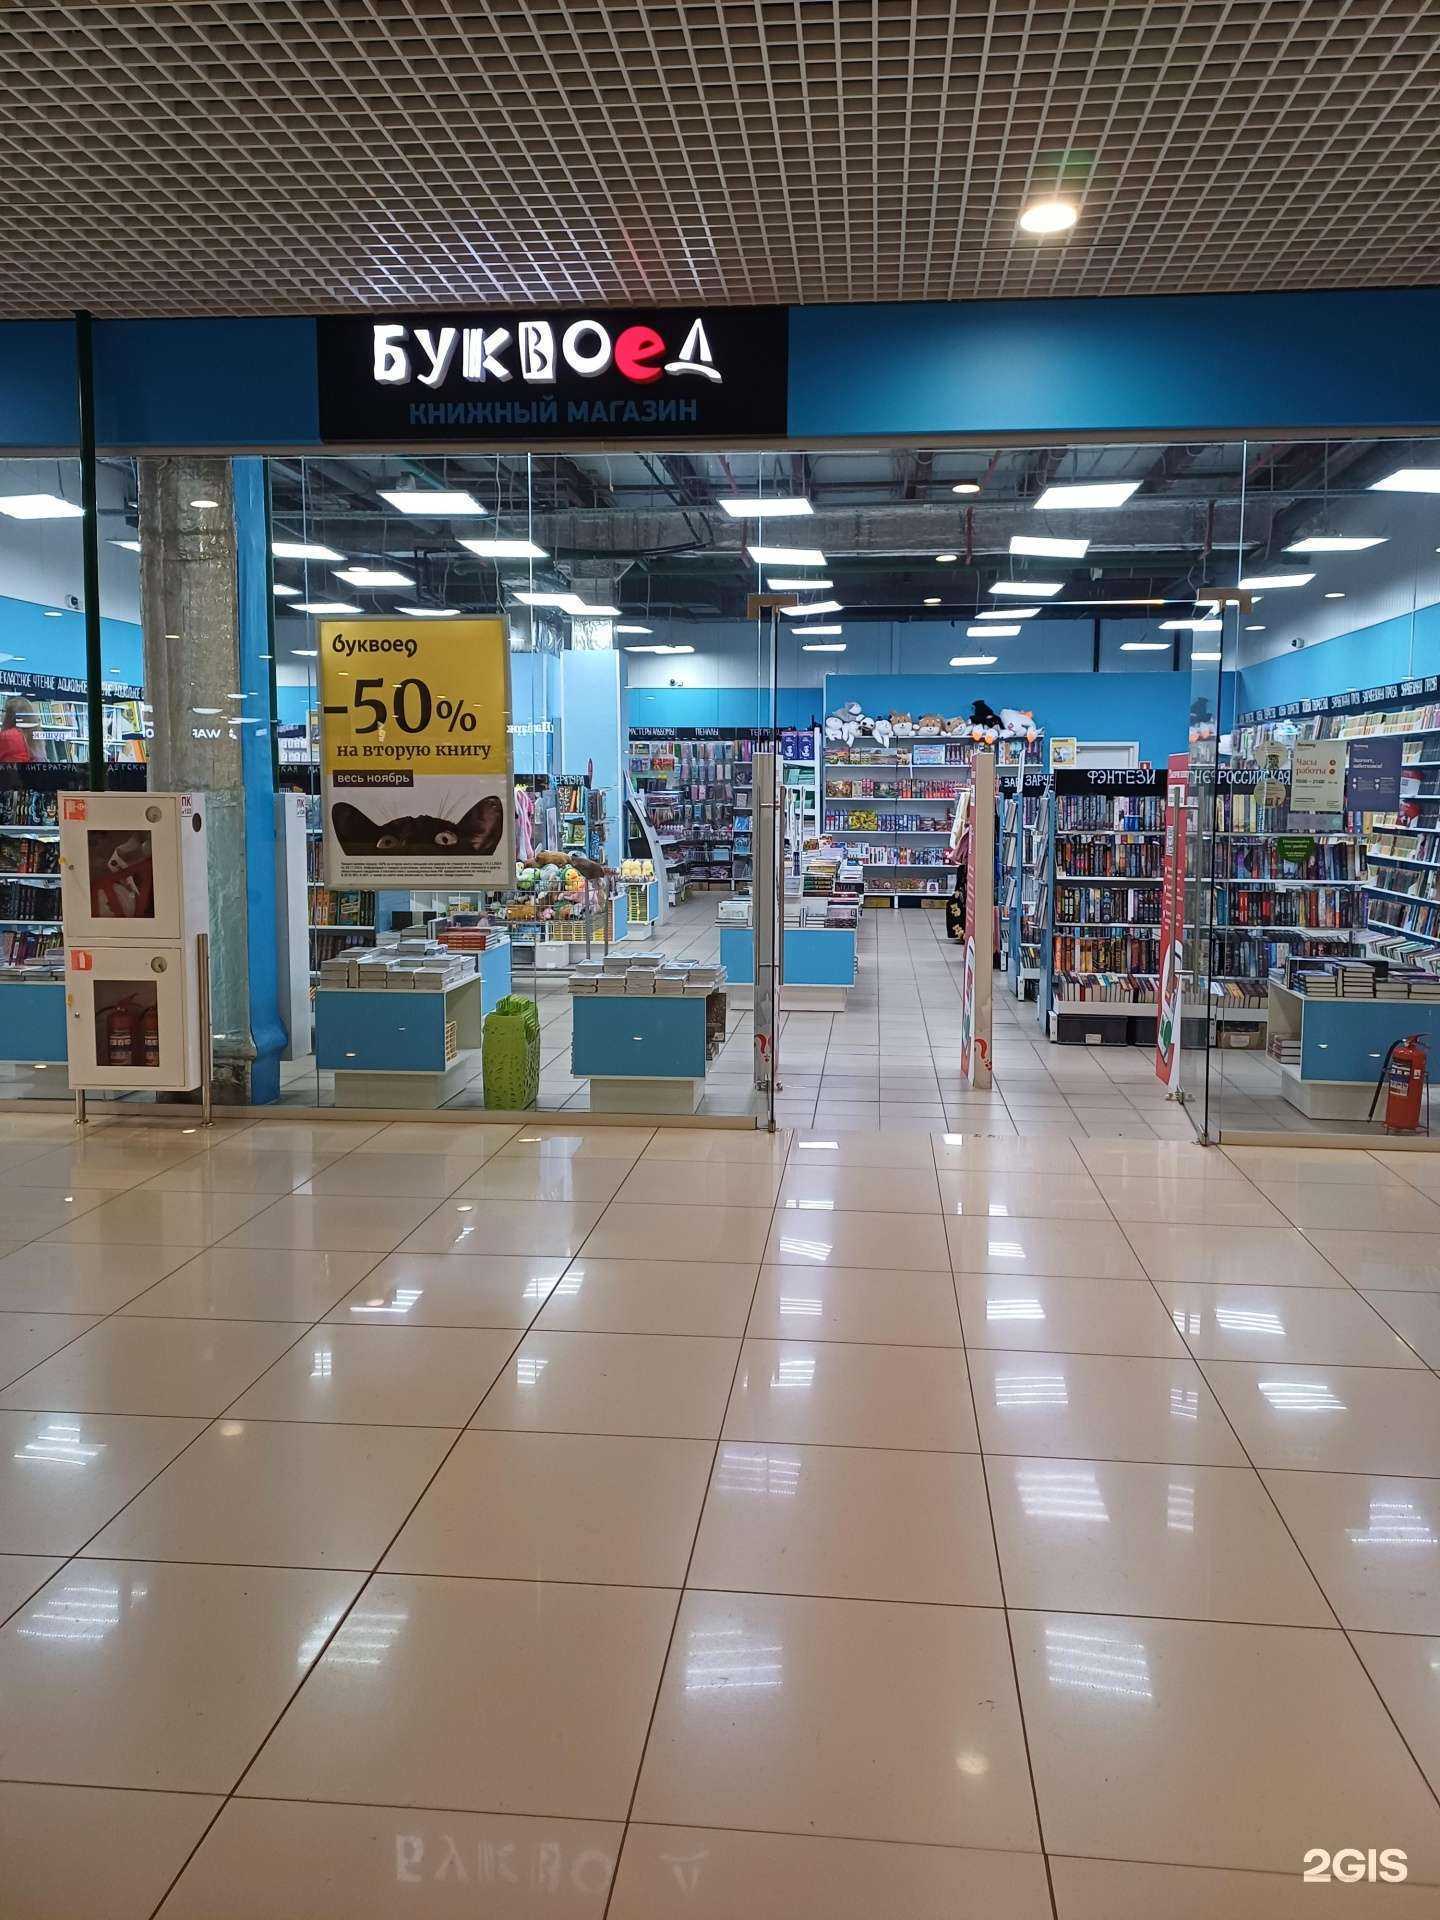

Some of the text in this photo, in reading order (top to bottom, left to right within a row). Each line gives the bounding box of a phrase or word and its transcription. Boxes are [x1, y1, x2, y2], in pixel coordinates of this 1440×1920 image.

[409, 395, 697, 424] КНИЖНЫЙ МАГАЗИН
[332, 634, 418, 657] буквоед
[336, 743, 492, 760] на вторую книгу
[1296, 757, 1318, 766] Часы
[337, 772, 410, 785] весь ноябрь
[1087, 769, 1157, 785] ФЭНТЕЗИ
[1217, 769, 1292, 786] РОССИЙСКАЯ
[1295, 767, 1328, 777] работы
[181, 796, 192, 806] ПК
